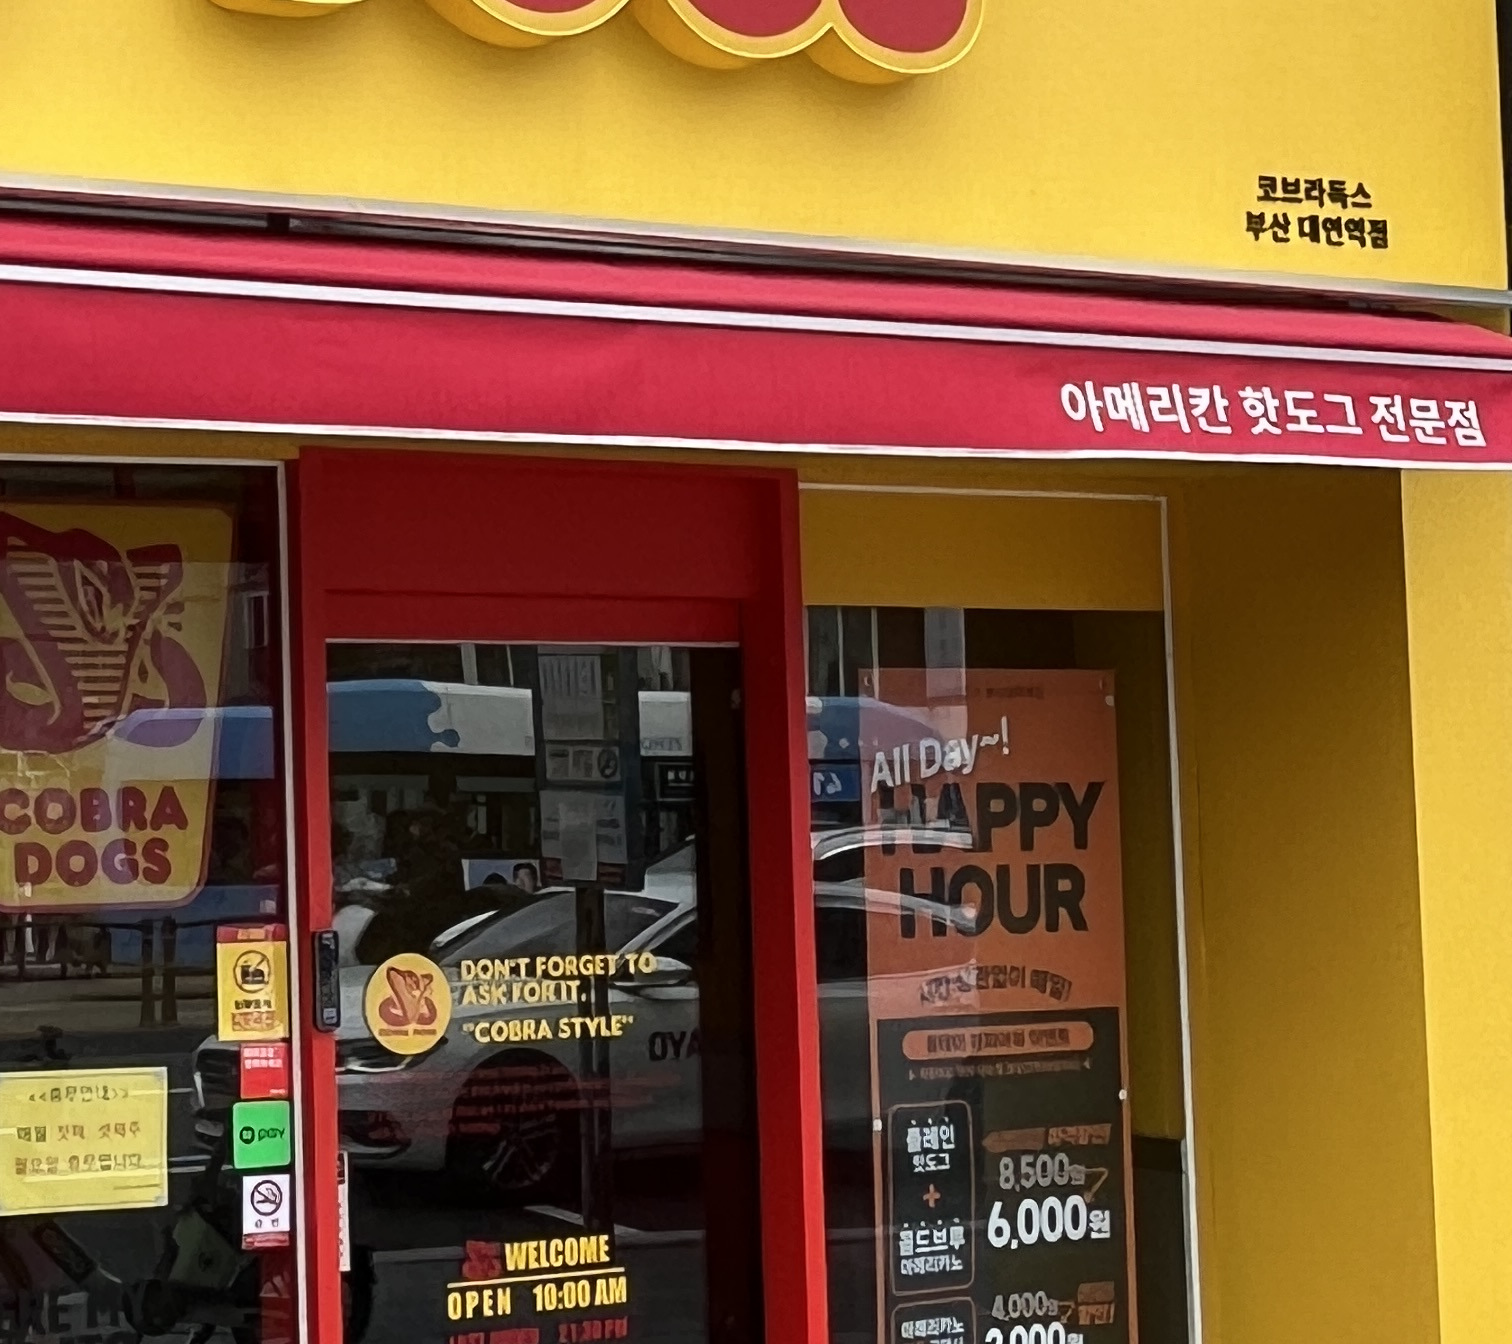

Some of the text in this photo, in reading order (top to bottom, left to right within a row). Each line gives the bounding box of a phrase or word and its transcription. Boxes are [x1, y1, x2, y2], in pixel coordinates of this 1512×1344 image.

[1256, 174, 1373, 209] 코브라독스
[1245, 211, 1389, 250] 부산 대연역점
[1060, 380, 1487, 448] 아메리칸 핫도그 전문점
[871, 743, 911, 792] All
[876, 781, 1108, 856] HAPPY
[14, 837, 172, 887] DOGS
[899, 863, 1089, 939] HOUR
[460, 952, 658, 981] DON'T FORGET TO
[461, 982, 507, 1006] ASK
[512, 981, 557, 1004] FOR
[987, 1194, 1111, 1250] 6,000원
[504, 1234, 610, 1272] WELCOME
[447, 1276, 627, 1320] OPEN 10:00 AM
